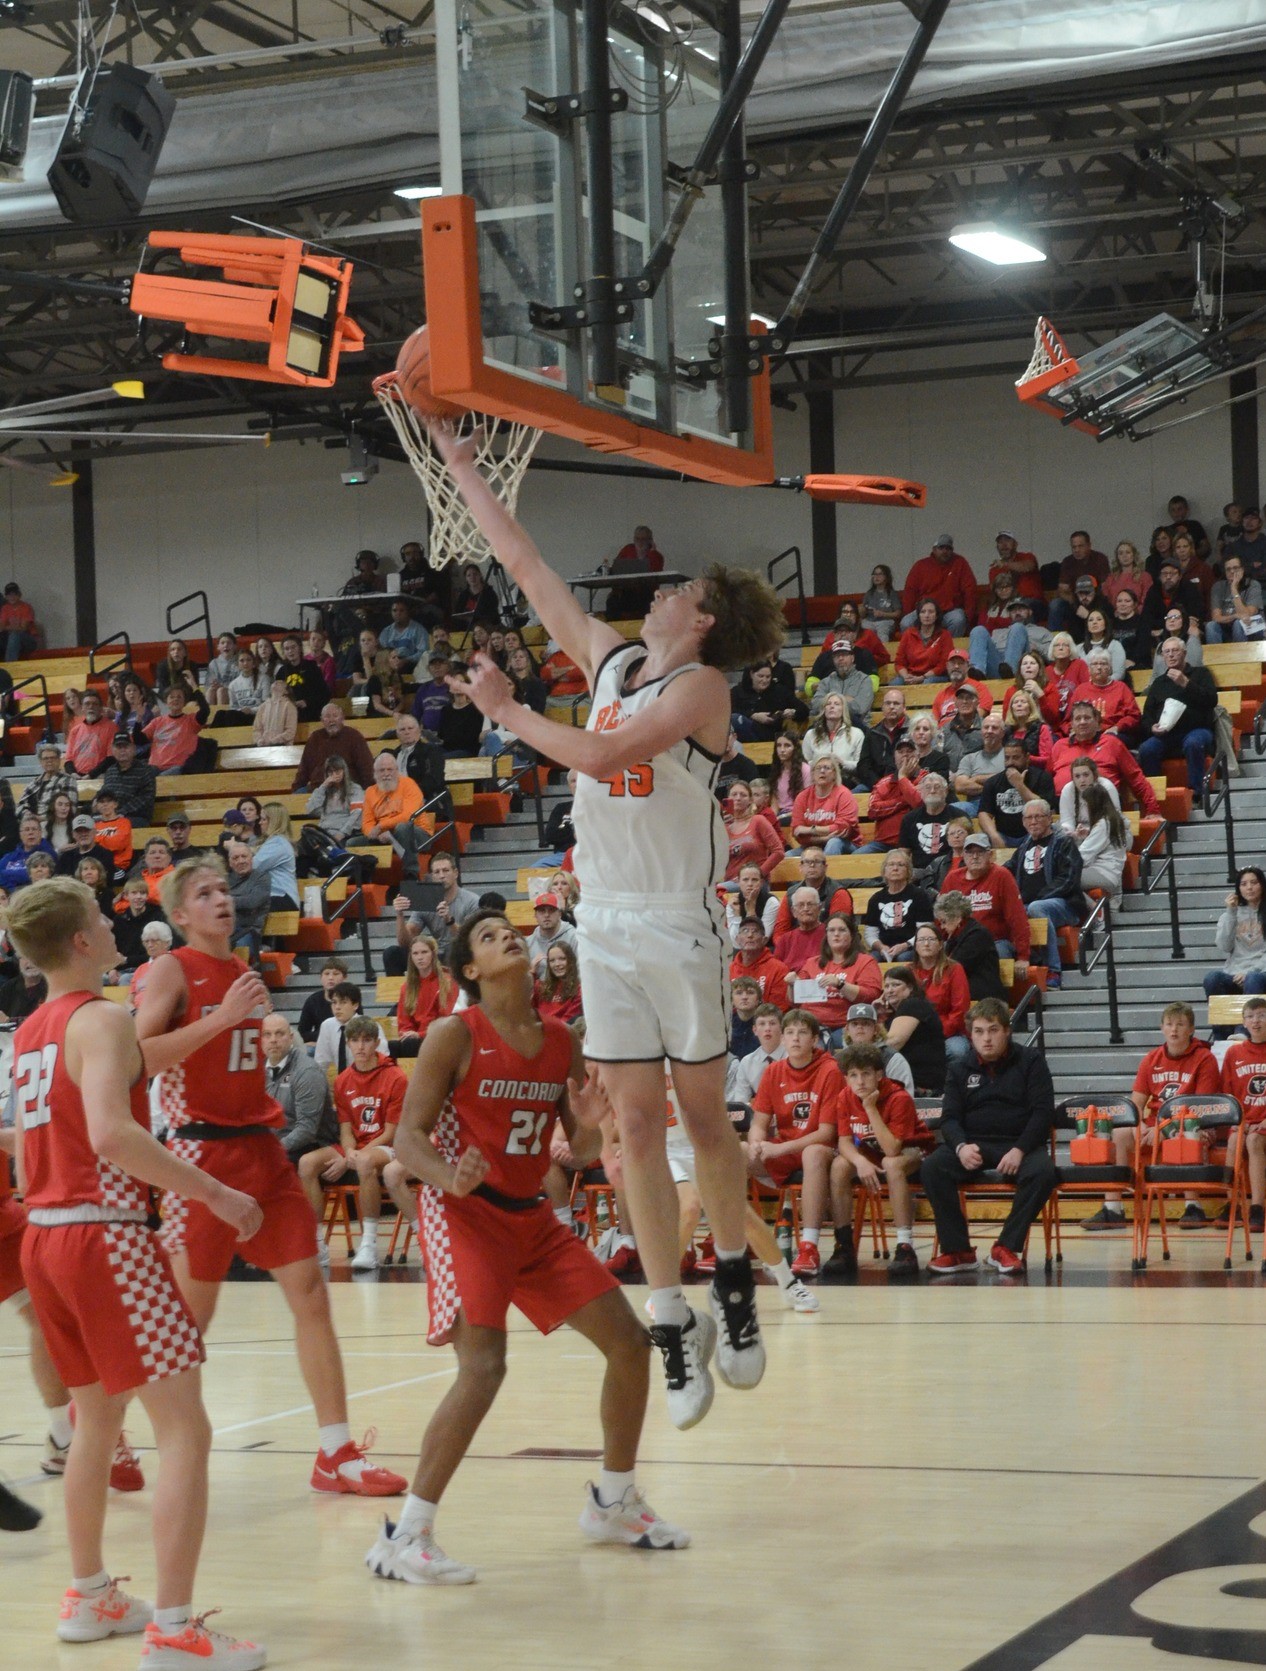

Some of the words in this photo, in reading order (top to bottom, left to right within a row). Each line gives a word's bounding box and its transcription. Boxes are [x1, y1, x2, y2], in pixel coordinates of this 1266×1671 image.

[227, 1028, 260, 1072] 15
[16, 1042, 58, 1131] 22
[1181, 1072, 1192, 1083] W
[478, 1079, 564, 1101] CONCORD
[1065, 1105, 1126, 1118] TRANS
[1170, 1104, 1230, 1118] TOJANS
[505, 1110, 548, 1155] 21
